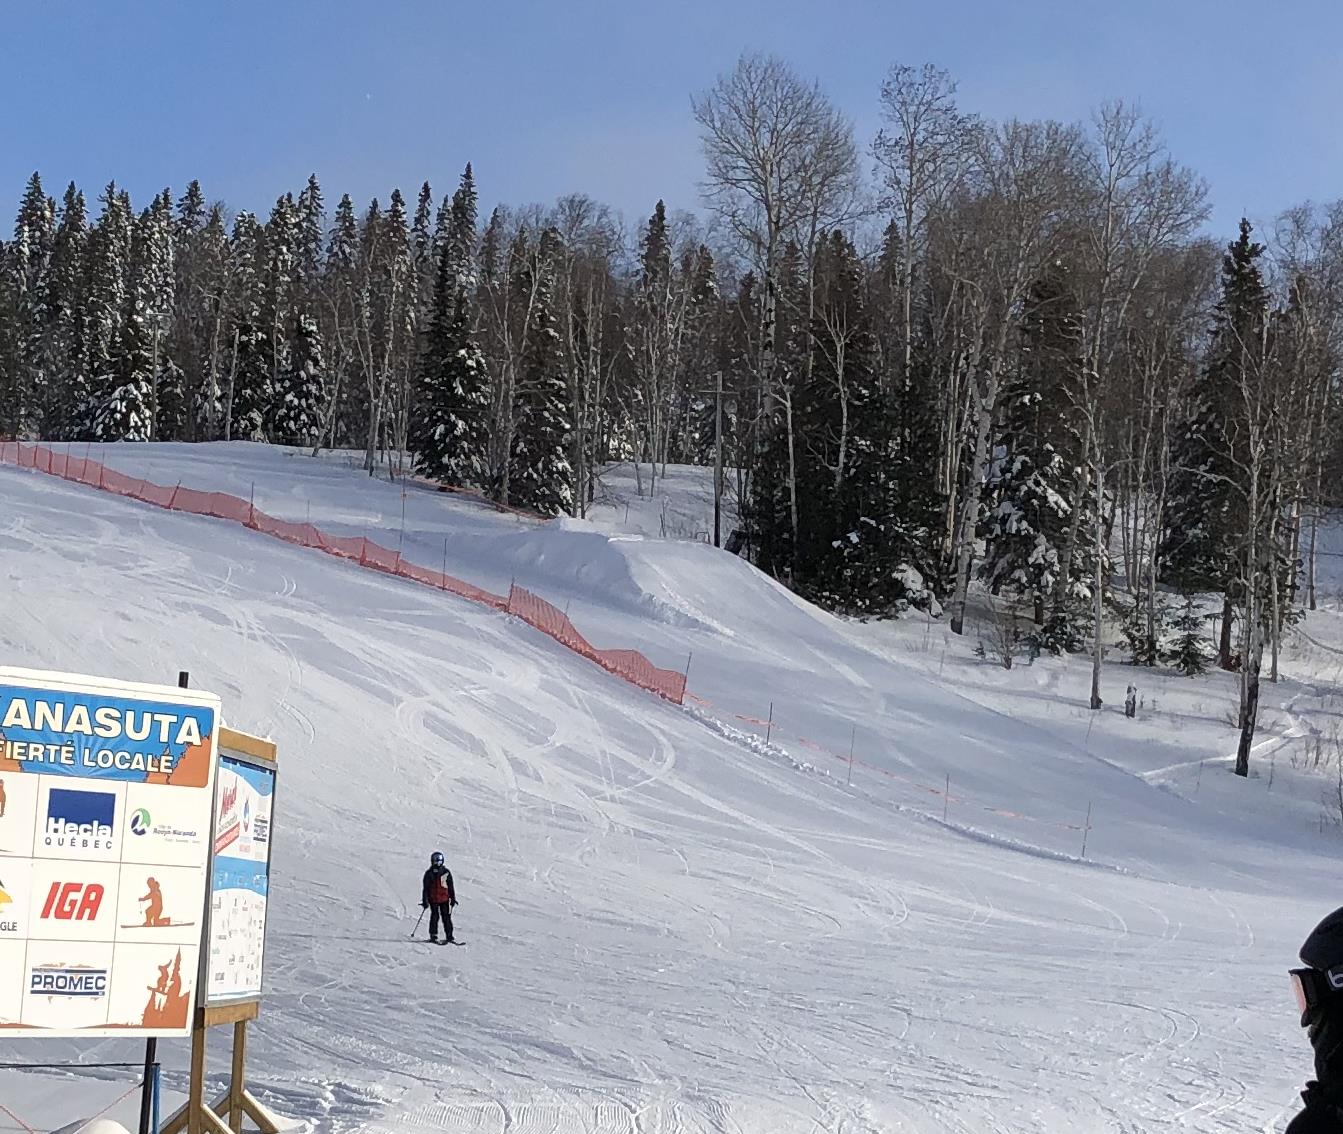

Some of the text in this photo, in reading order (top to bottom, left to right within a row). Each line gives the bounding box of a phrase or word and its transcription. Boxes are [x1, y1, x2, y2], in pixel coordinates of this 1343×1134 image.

[83, 746, 174, 774] LOCALE
[47, 816, 111, 837] Hecla
[45, 836, 113, 850] QUÉBEC
[39, 881, 106, 921] IGA
[30, 974, 107, 991] PROMEC
